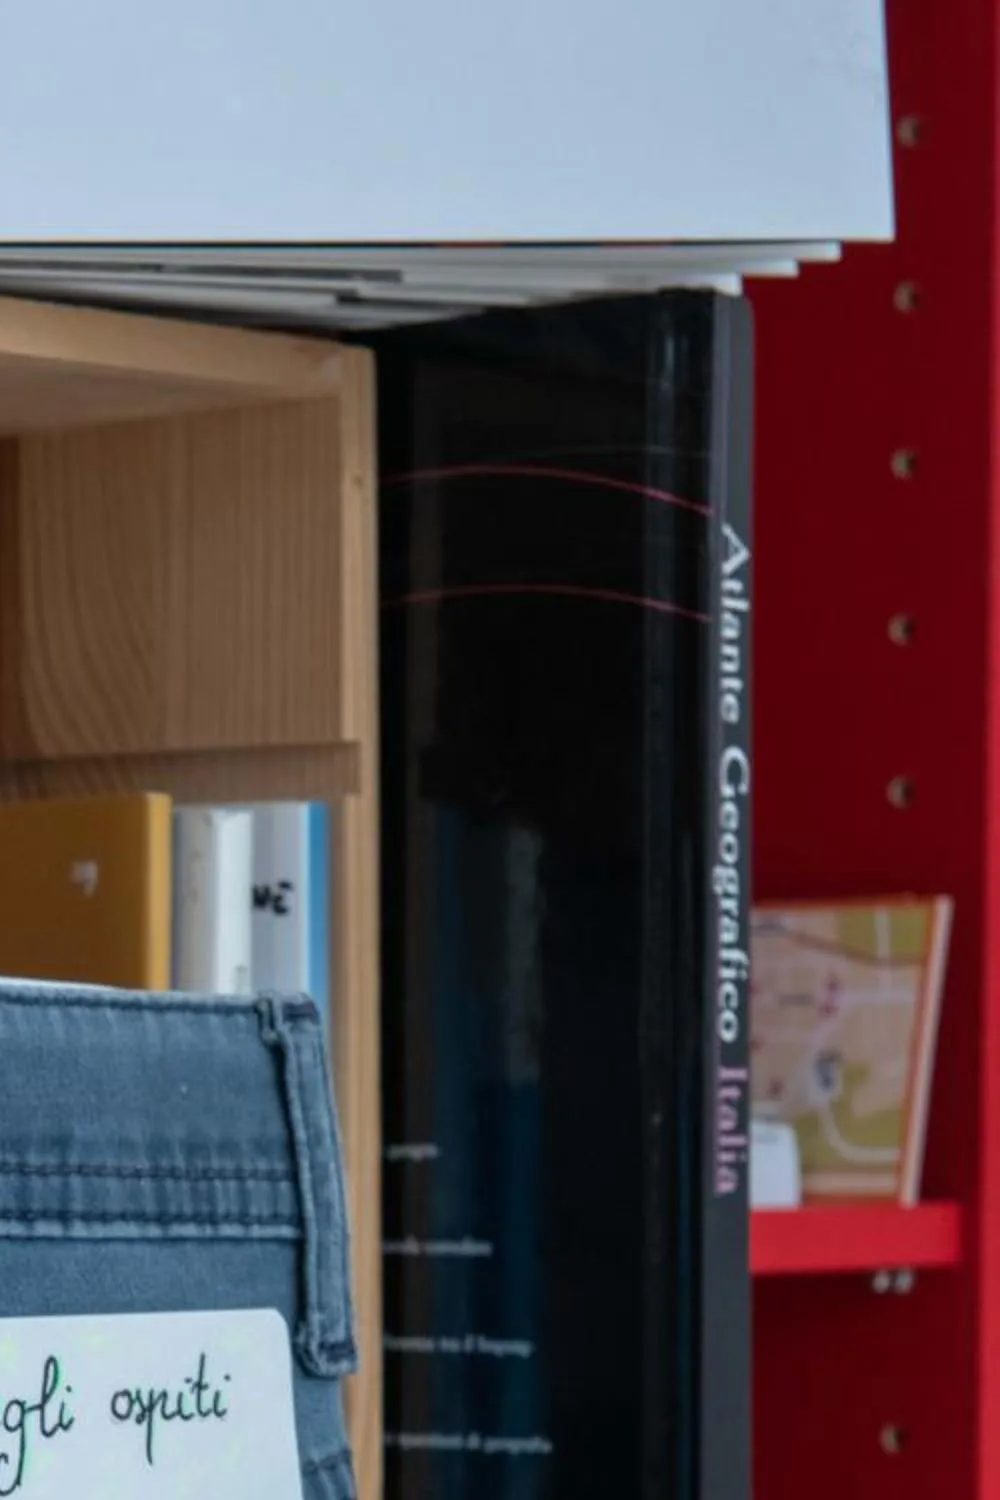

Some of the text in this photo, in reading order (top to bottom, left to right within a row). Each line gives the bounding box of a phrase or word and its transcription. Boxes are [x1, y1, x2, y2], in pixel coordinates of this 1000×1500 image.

[712, 522, 750, 1194] Atlante Geografico Italia
